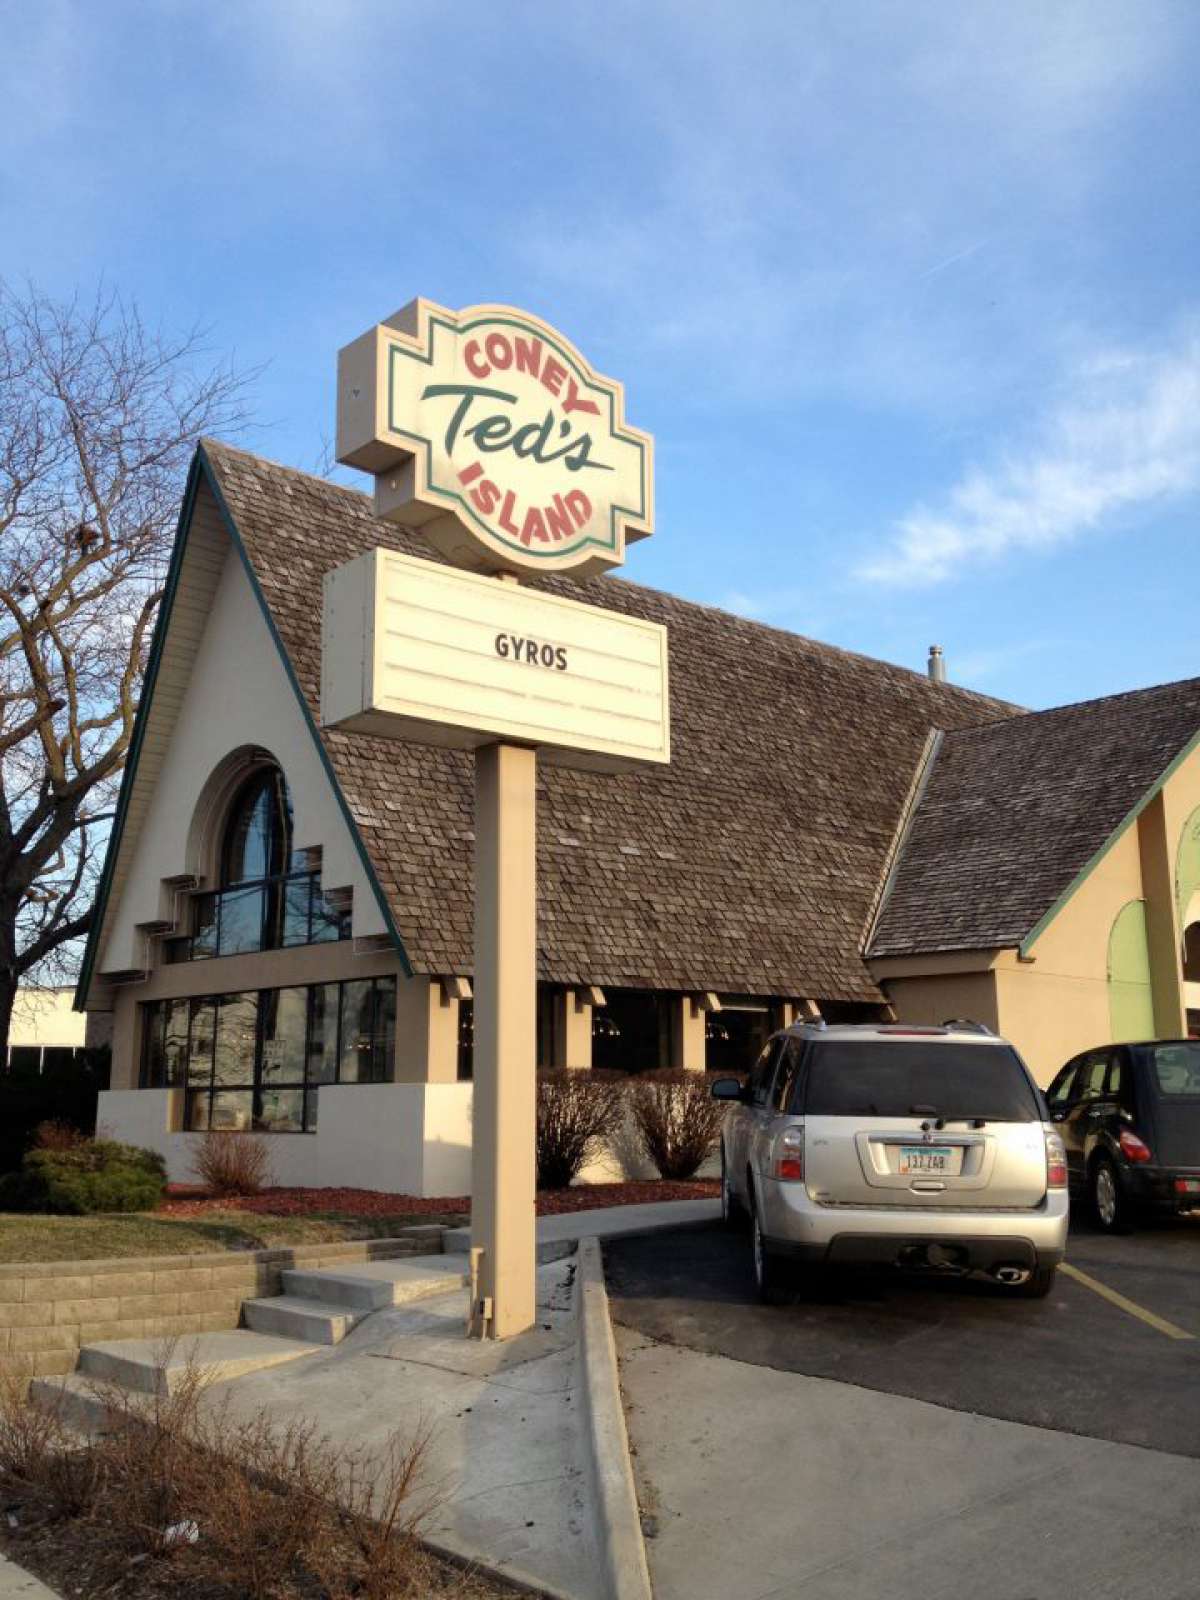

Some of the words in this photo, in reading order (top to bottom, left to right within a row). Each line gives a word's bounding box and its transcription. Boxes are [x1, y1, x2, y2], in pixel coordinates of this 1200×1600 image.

[464, 334, 599, 416] CONEY
[421, 384, 614, 472] Ted's
[458, 461, 593, 546] ISLAND
[495, 633, 568, 671] GYROS
